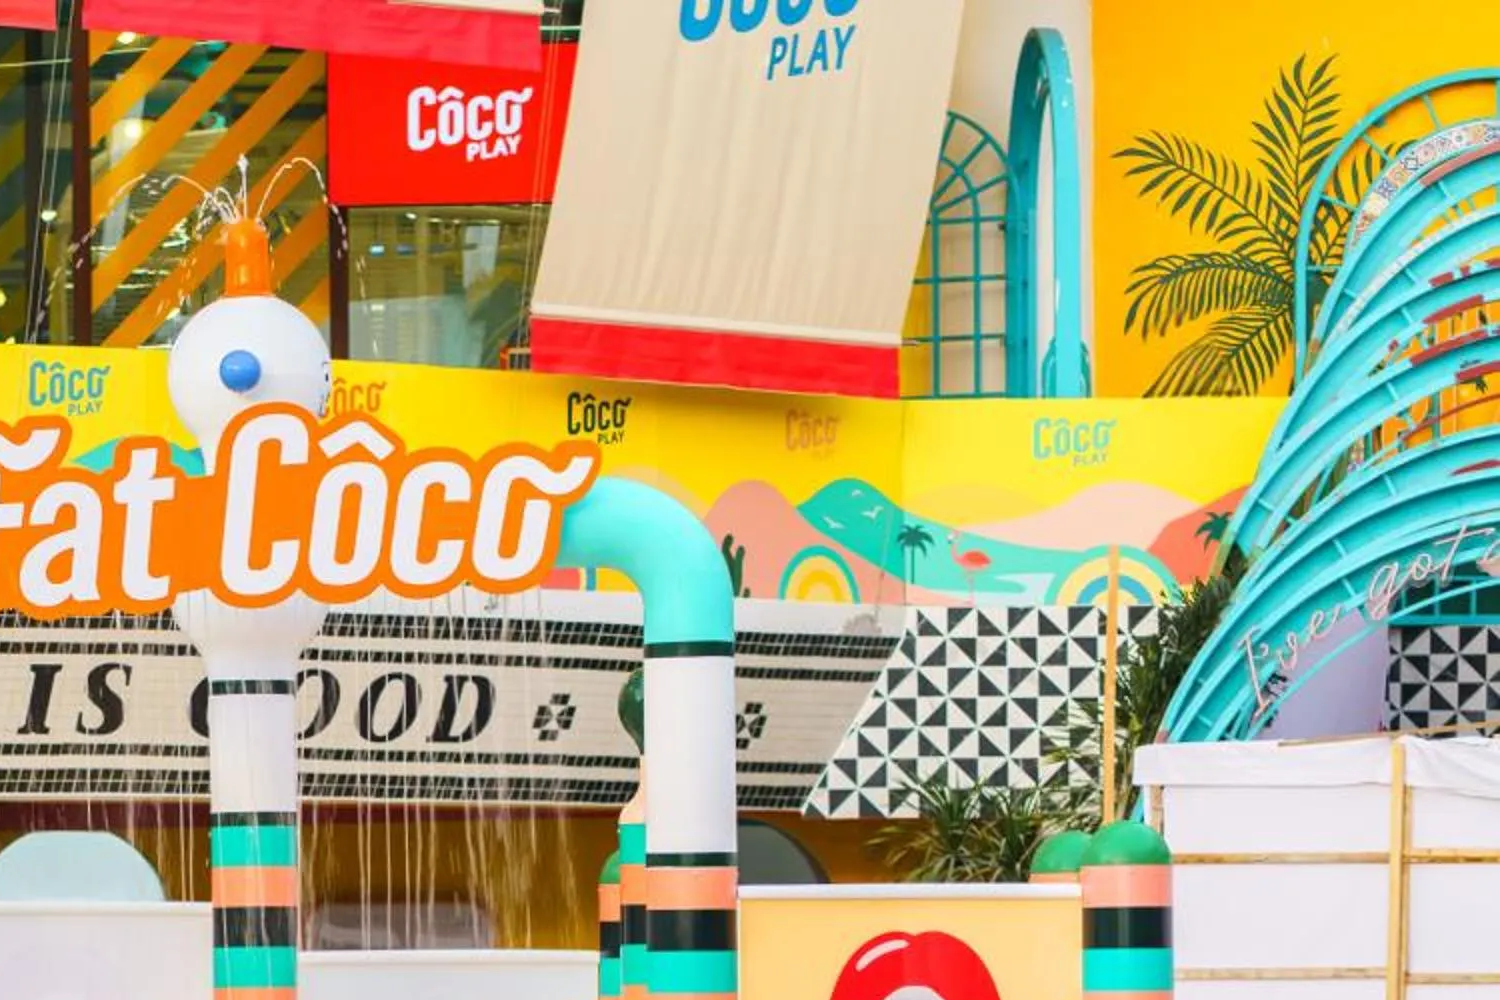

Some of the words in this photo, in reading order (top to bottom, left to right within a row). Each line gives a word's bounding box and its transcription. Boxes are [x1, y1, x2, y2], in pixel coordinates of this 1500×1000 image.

[766, 25, 856, 80] PLAY
[466, 134, 521, 162] PLAY
[67, 401, 103, 416] PLAY
[596, 431, 625, 445] PLAY
[17, 663, 133, 735] IS
